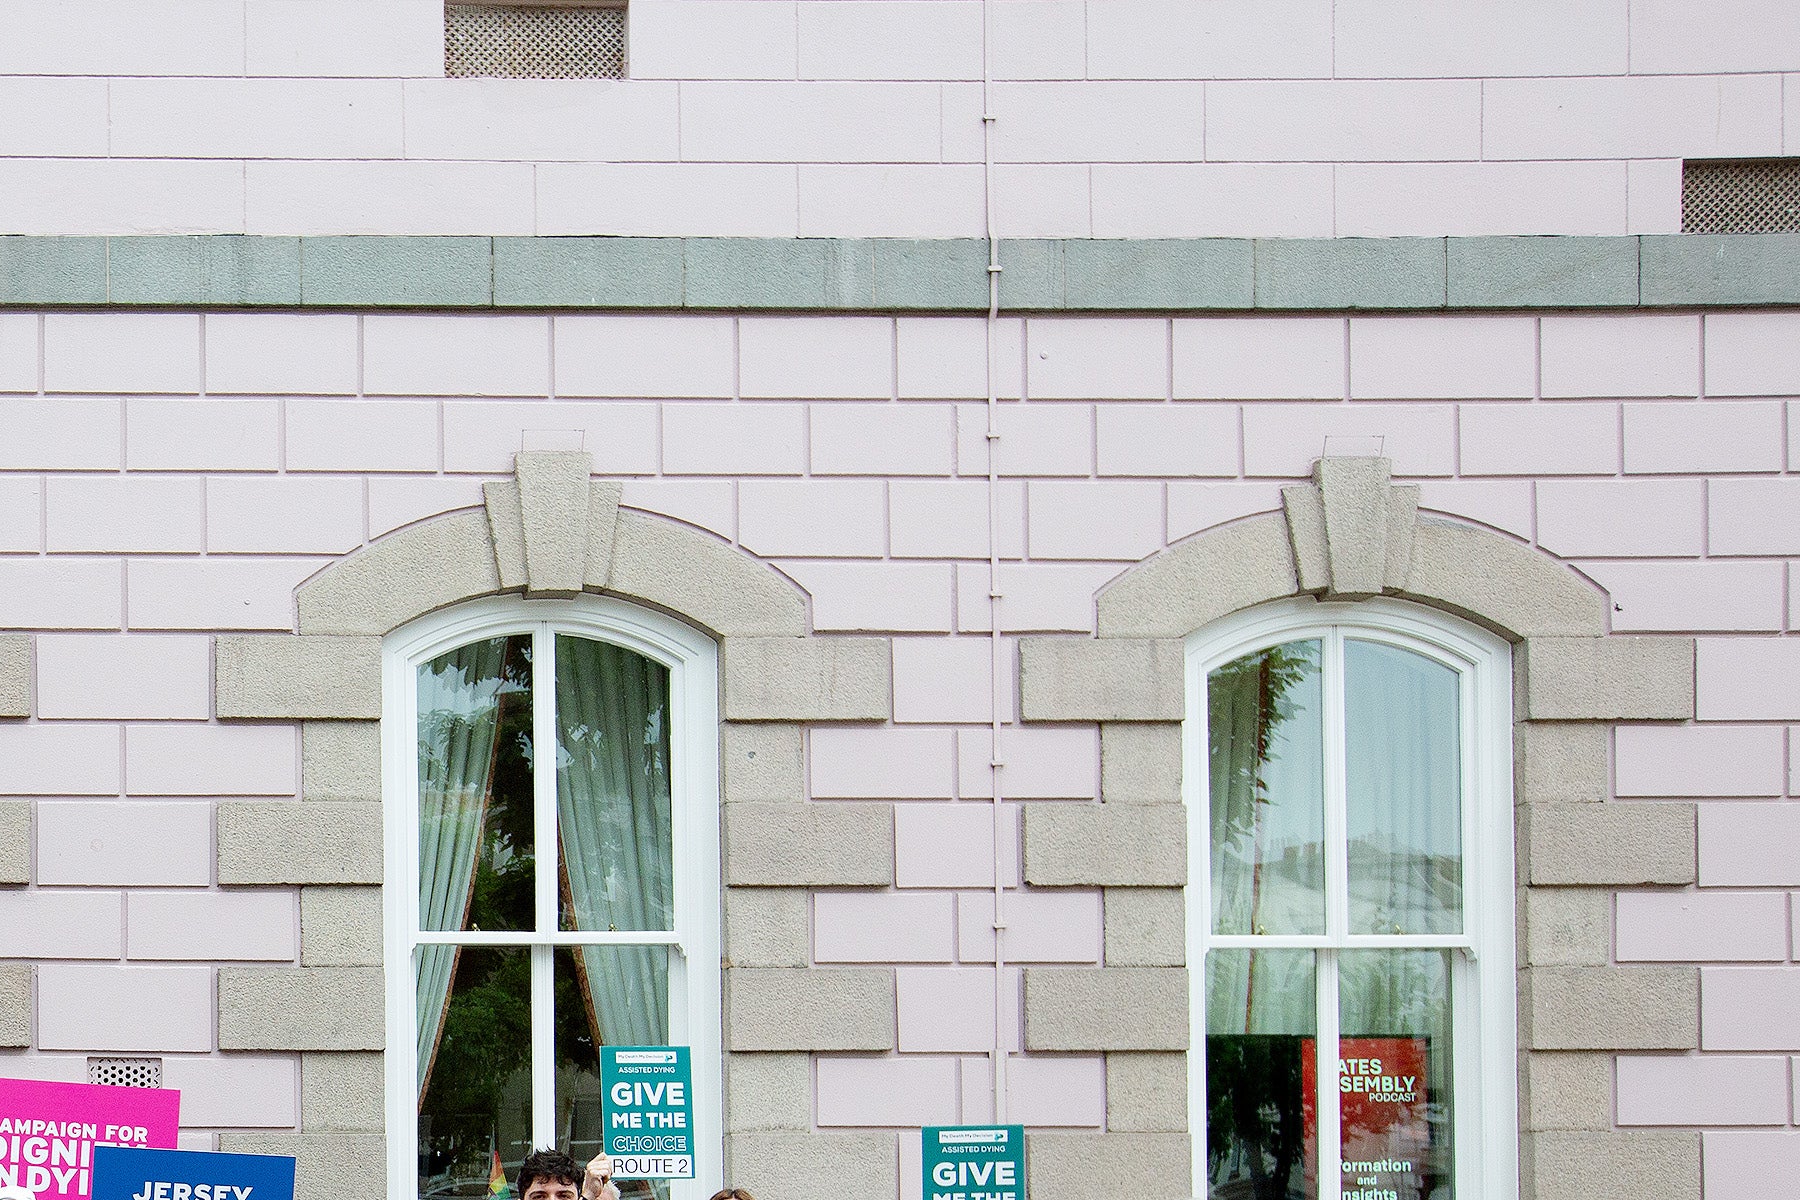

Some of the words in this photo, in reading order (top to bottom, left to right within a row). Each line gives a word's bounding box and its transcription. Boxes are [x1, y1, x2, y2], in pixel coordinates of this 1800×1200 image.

[618, 1066, 652, 1074] ASSISTED
[654, 1066, 676, 1074] DYING
[1339, 1058, 1382, 1075] ATES
[1340, 1076, 1416, 1093] SEMBLY
[610, 1082, 686, 1106] GIVE
[1369, 1092, 1417, 1103] PODCAST
[611, 1112, 642, 1128] ME
[646, 1112, 687, 1128] THE
[105, 1124, 148, 1143] FOR
[613, 1135, 687, 1152] CHOICE
[941, 1145, 980, 1154] ASSISTED
[981, 1145, 1006, 1153] DYING
[613, 1158, 673, 1174] ROUTE
[678, 1158, 688, 1174] 2
[1341, 1158, 1412, 1173] ormation
[26, 1165, 89, 1196] DYI
[932, 1161, 1016, 1187] GIVE
[1356, 1174, 1377, 1186] and
